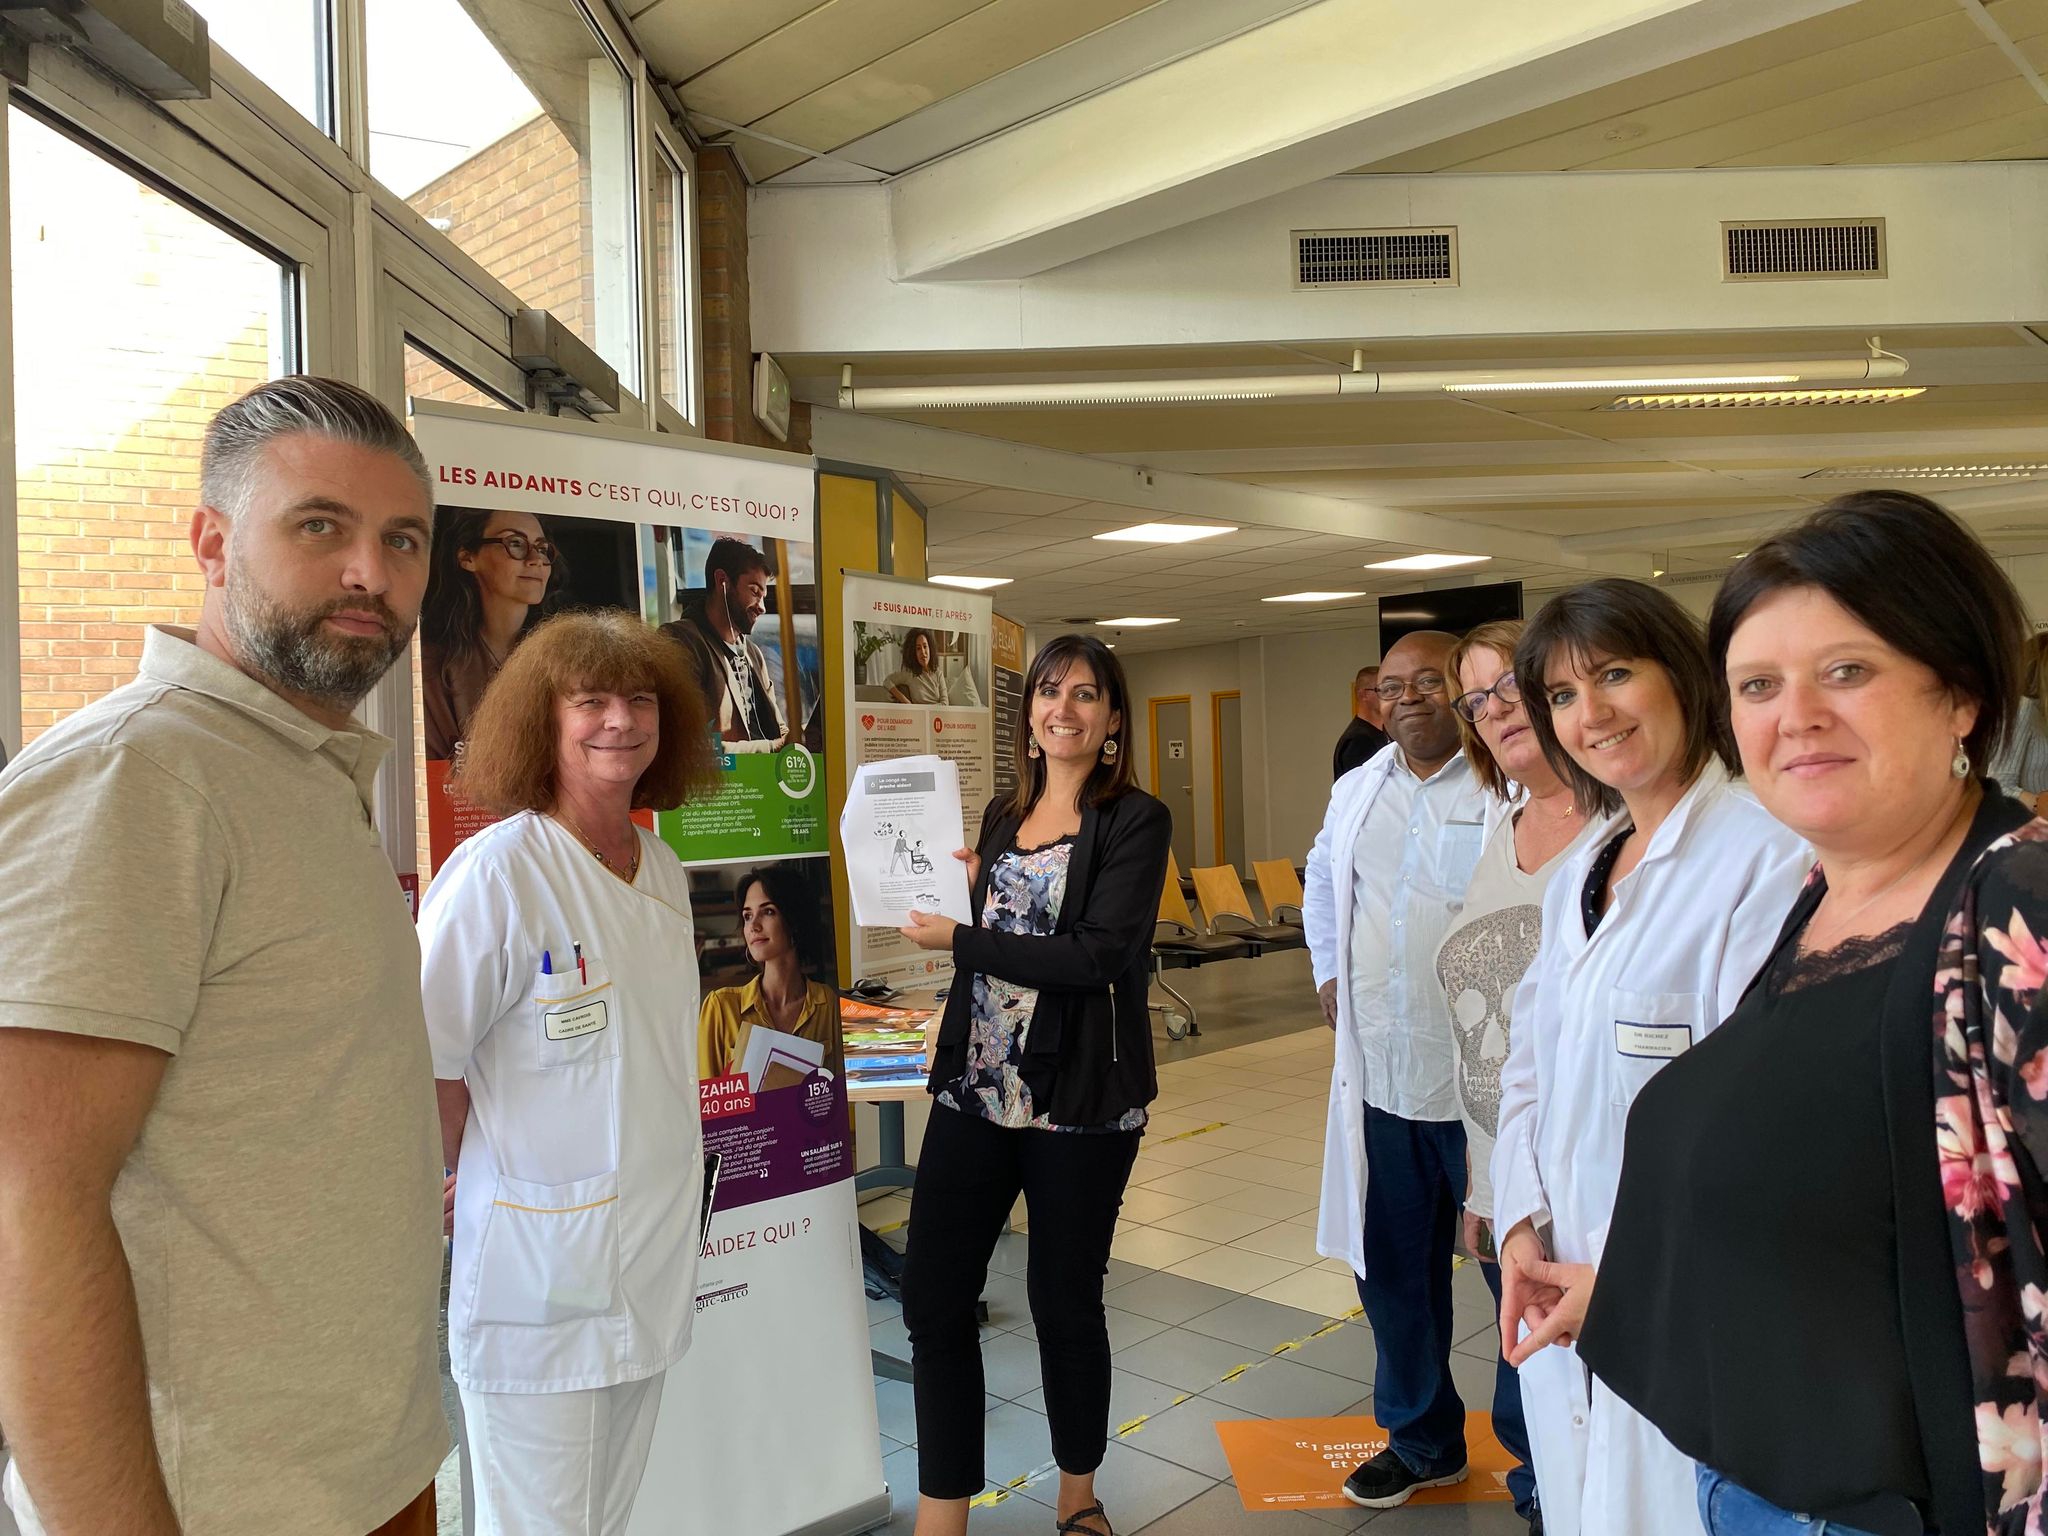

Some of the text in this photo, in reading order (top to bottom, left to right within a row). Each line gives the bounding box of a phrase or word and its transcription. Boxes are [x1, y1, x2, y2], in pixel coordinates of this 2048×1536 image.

[440, 465, 799, 522] LES AIDANTS C'EST QUI, C'EST QUOI ?
[872, 601, 973, 622] JE SUIS AIDANT, ET APRÈS ?
[786, 756, 807, 769] 61%
[700, 1079, 745, 1099] ZAHIA
[808, 1081, 830, 1097] 15%
[701, 1097, 751, 1115] 40 ans
[703, 1133, 738, 1145] accompagne
[753, 1126, 775, 1136] conjoint
[800, 1149, 810, 1158] UN
[830, 1142, 839, 1150] SUR
[730, 1159, 743, 1168] pour
[703, 1217, 812, 1260] AIDEZ QUI ?
[694, 1288, 748, 1313] girc-arrco
[1323, 1440, 1387, 1451] salarié
[1322, 1451, 1352, 1460] est
[1330, 1460, 1349, 1469] Et
